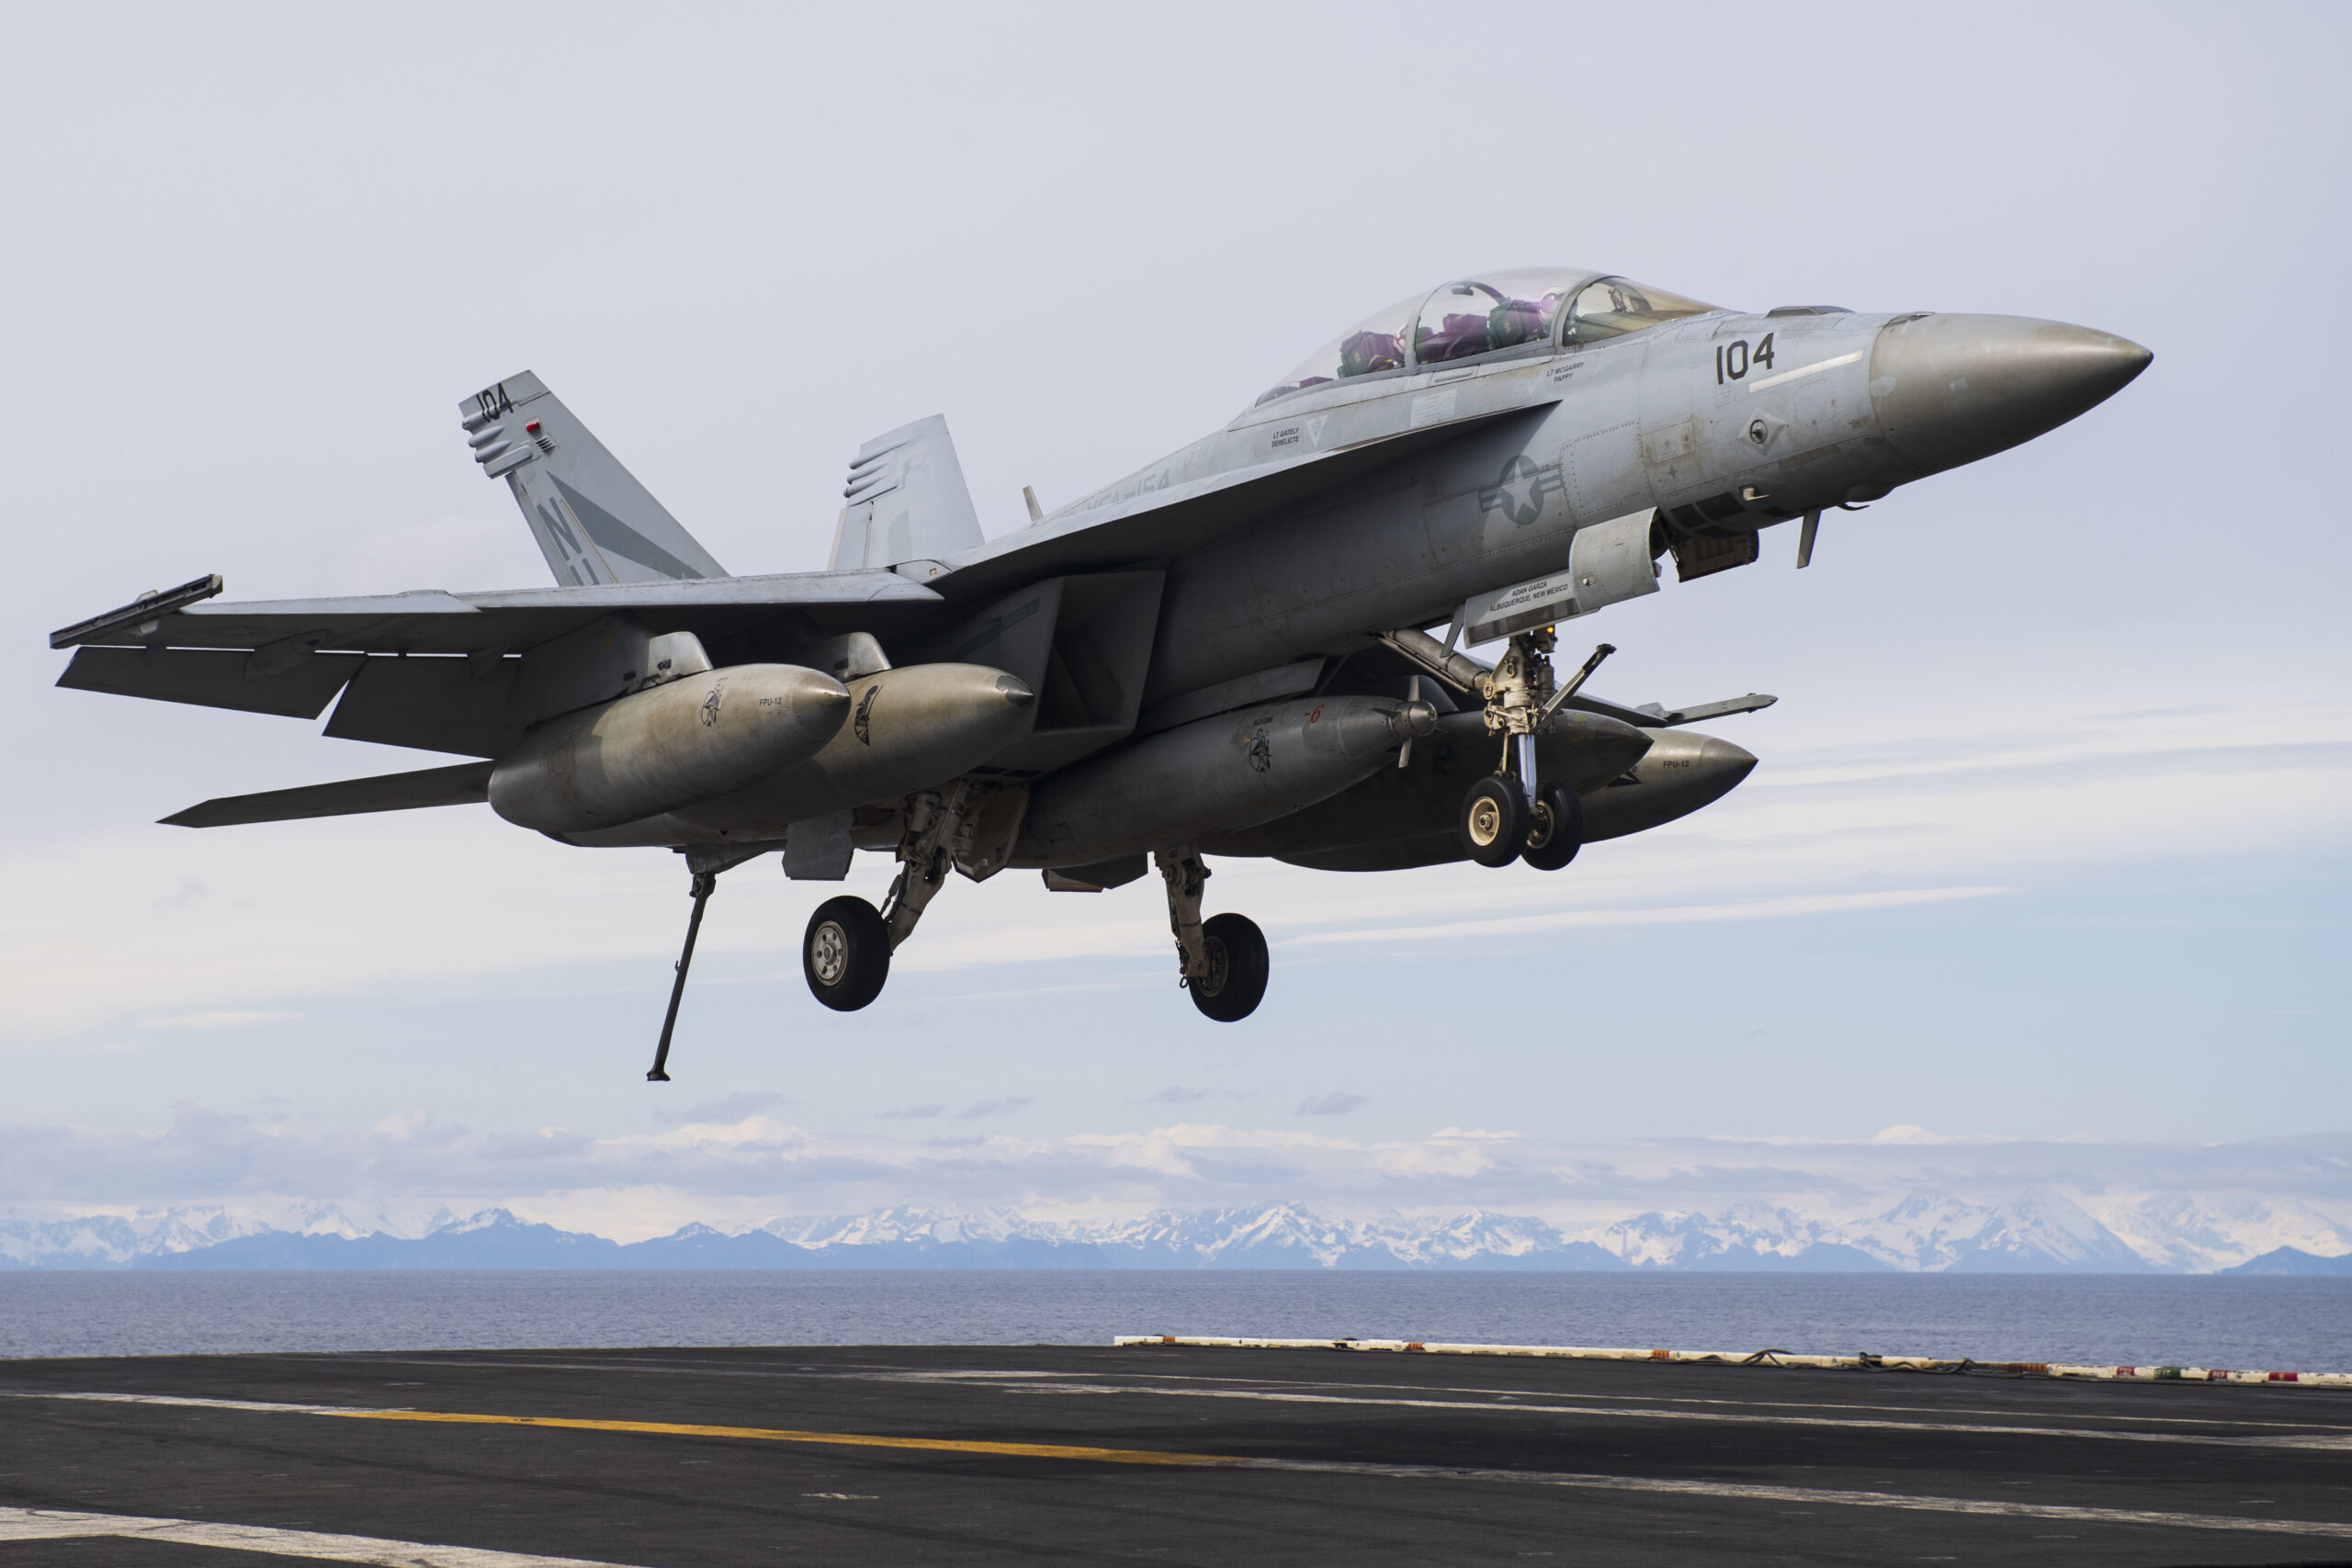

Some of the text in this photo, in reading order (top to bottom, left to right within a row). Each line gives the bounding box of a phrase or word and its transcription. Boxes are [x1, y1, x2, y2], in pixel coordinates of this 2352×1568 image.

[1716, 332, 1775, 385] 104
[1554, 372, 1574, 383] PAPPY
[476, 382, 514, 423] 104
[1280, 427, 1300, 437] GATELY
[1272, 435, 1300, 448] DERELICTE
[1511, 581, 1547, 597] ADAN GARZA
[1532, 590, 1546, 600] NEW
[1546, 583, 1568, 595] MEXICO
[759, 696, 783, 706] FPU-12
[1662, 760, 1690, 769] FPU-12
